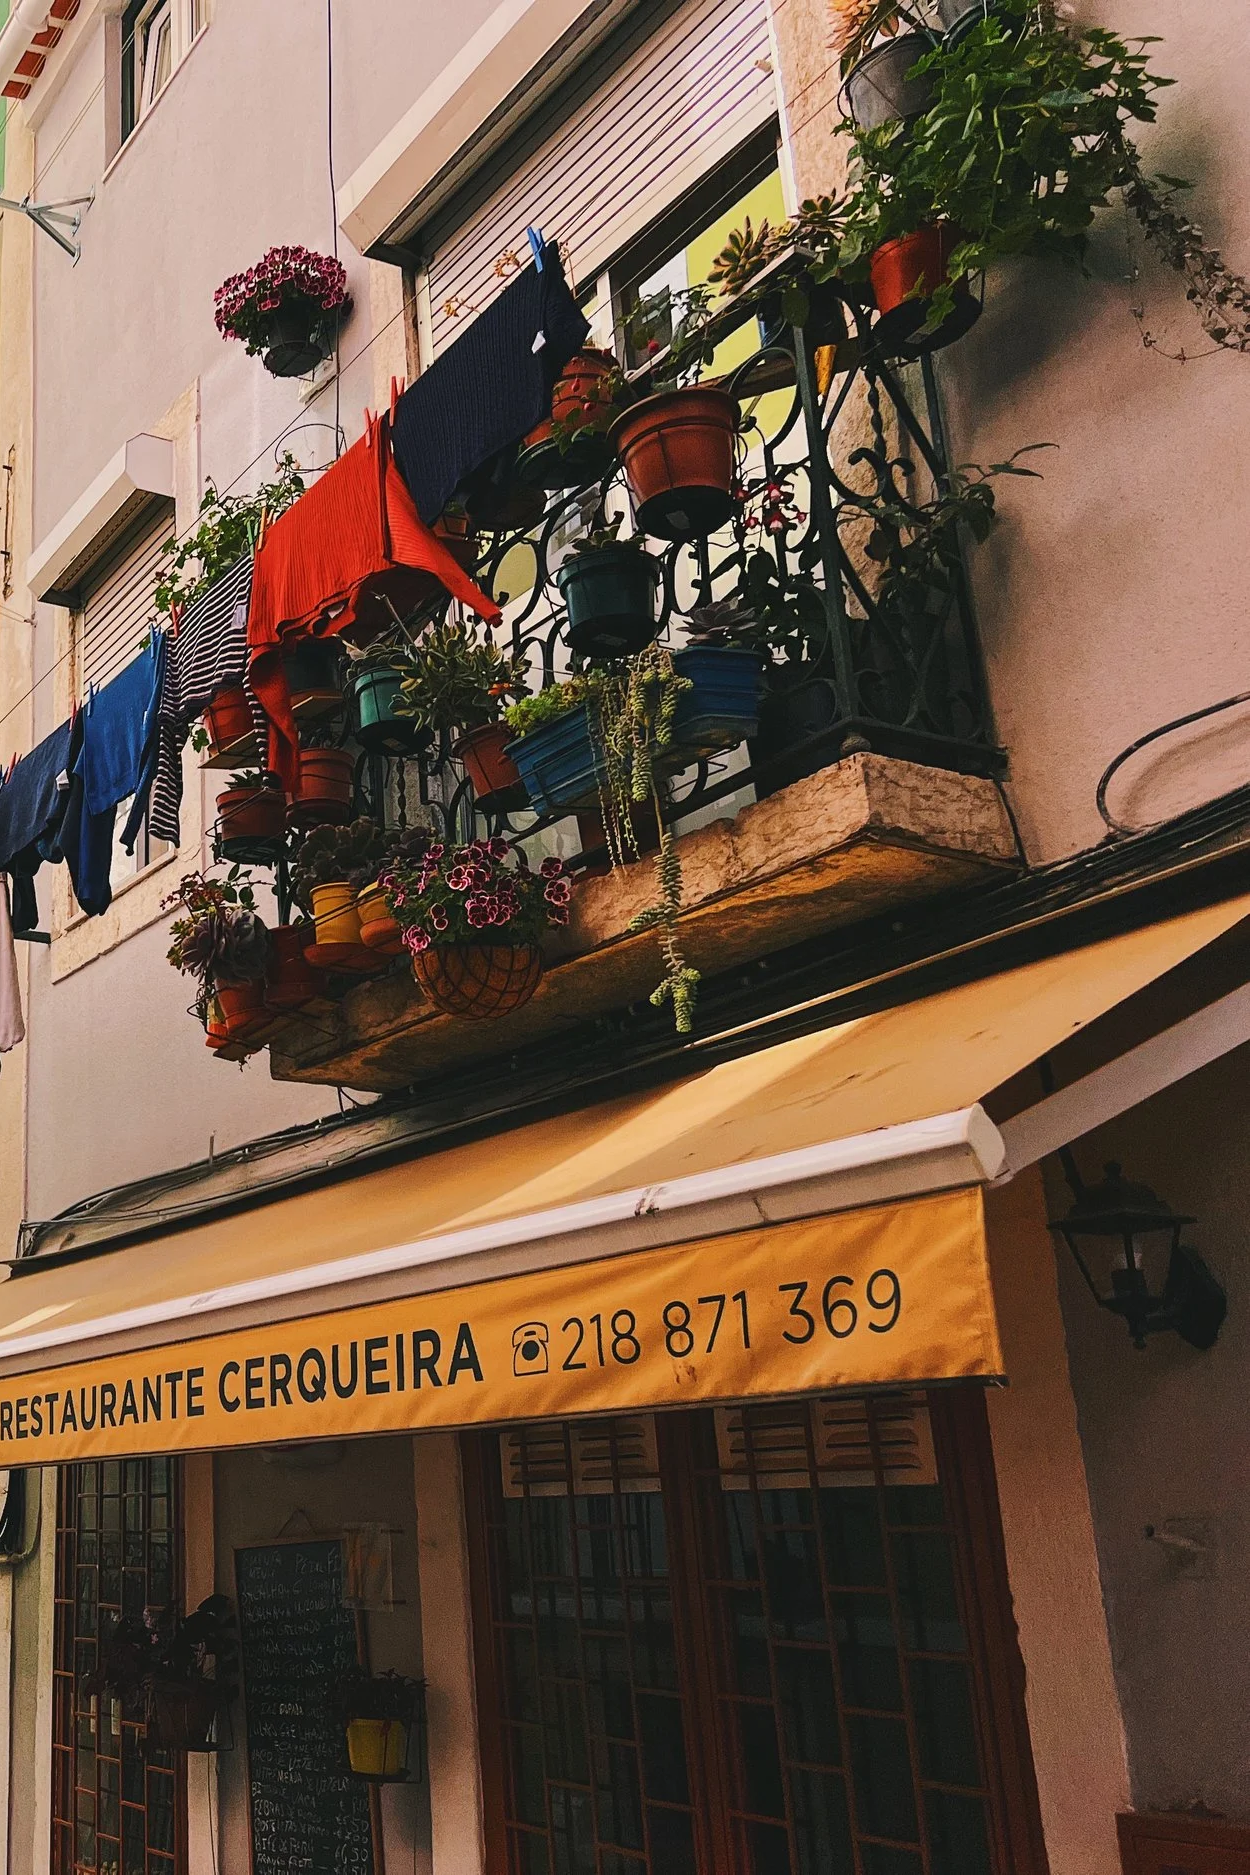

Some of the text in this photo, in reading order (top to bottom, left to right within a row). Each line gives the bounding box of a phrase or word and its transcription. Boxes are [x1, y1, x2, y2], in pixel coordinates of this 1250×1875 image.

[0, 1268, 903, 1442] RESTAURANTE CERQUEIRA 218 871 369
